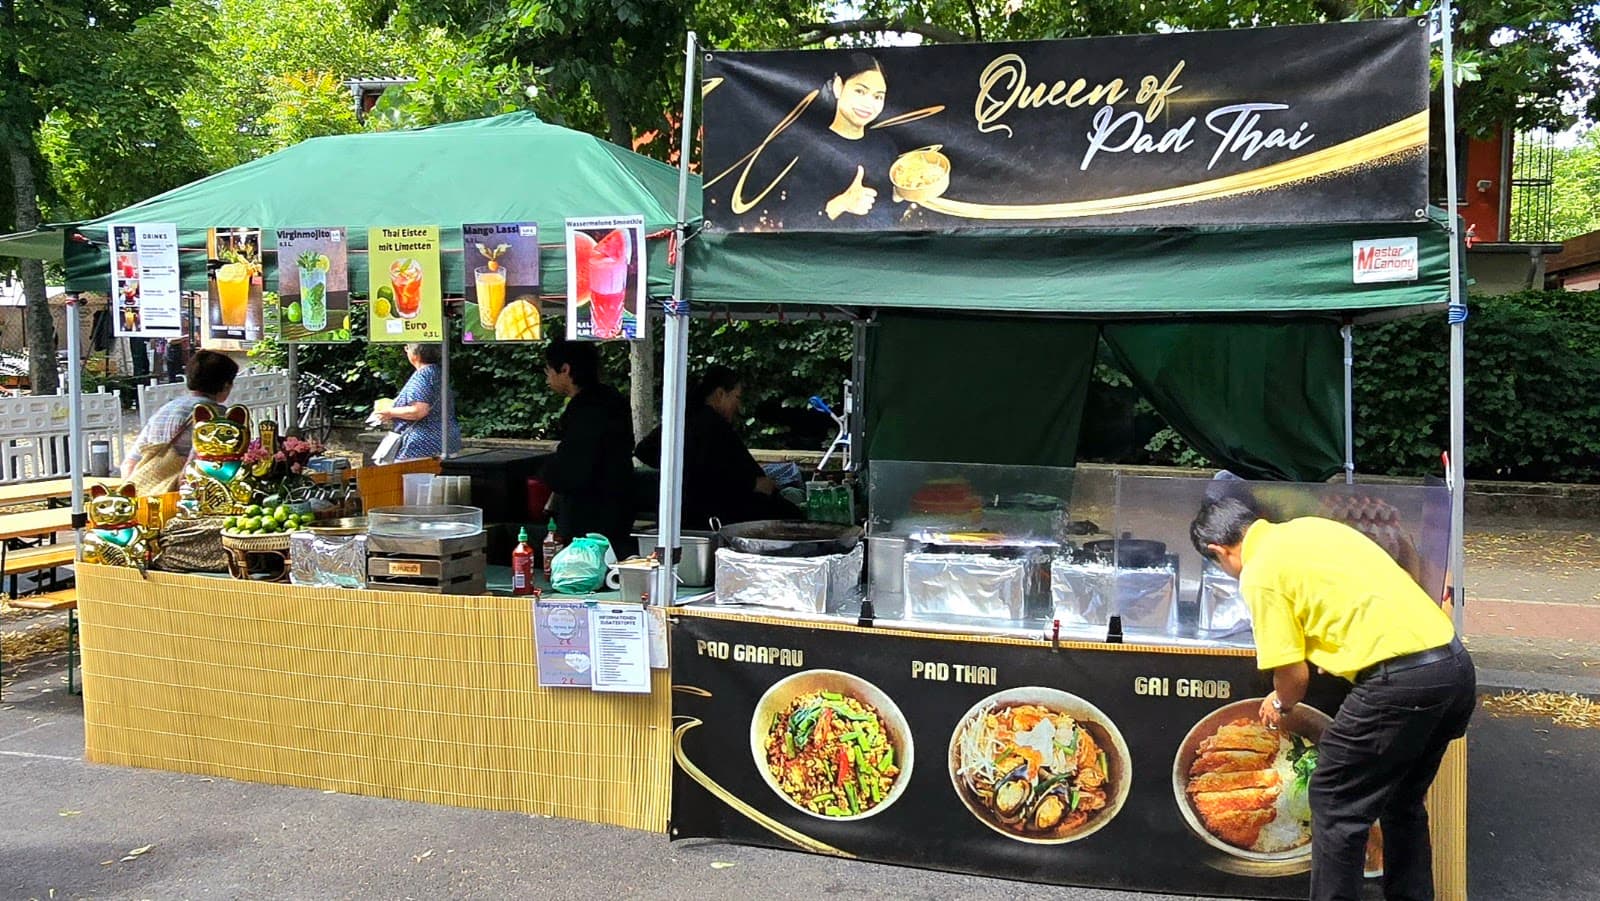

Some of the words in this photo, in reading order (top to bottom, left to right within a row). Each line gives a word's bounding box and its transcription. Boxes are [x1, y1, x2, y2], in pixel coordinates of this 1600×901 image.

[974, 53, 1128, 138] Queen
[1136, 60, 1186, 123] of
[1079, 105, 1197, 170] Pad
[1206, 102, 1315, 170] Thai
[566, 220, 612, 228] Wassermelone
[612, 218, 643, 226] Smoothie
[277, 230, 330, 241] Virginmojito
[382, 228, 400, 238] Thai
[402, 228, 427, 237] Eistee
[464, 225, 495, 237] Mango
[496, 224, 519, 234] Lassi
[378, 243, 393, 252] mit
[394, 242, 431, 252] Limetten
[1357, 245, 1405, 271] Master
[1374, 258, 1415, 272] Canopy
[404, 321, 428, 330] Euro
[697, 639, 730, 660] PAD
[733, 643, 804, 667] GRAPAU
[911, 660, 949, 682] PAD
[952, 664, 997, 686] THAI
[1134, 676, 1169, 697] GAI
[1176, 678, 1231, 699] GROB
